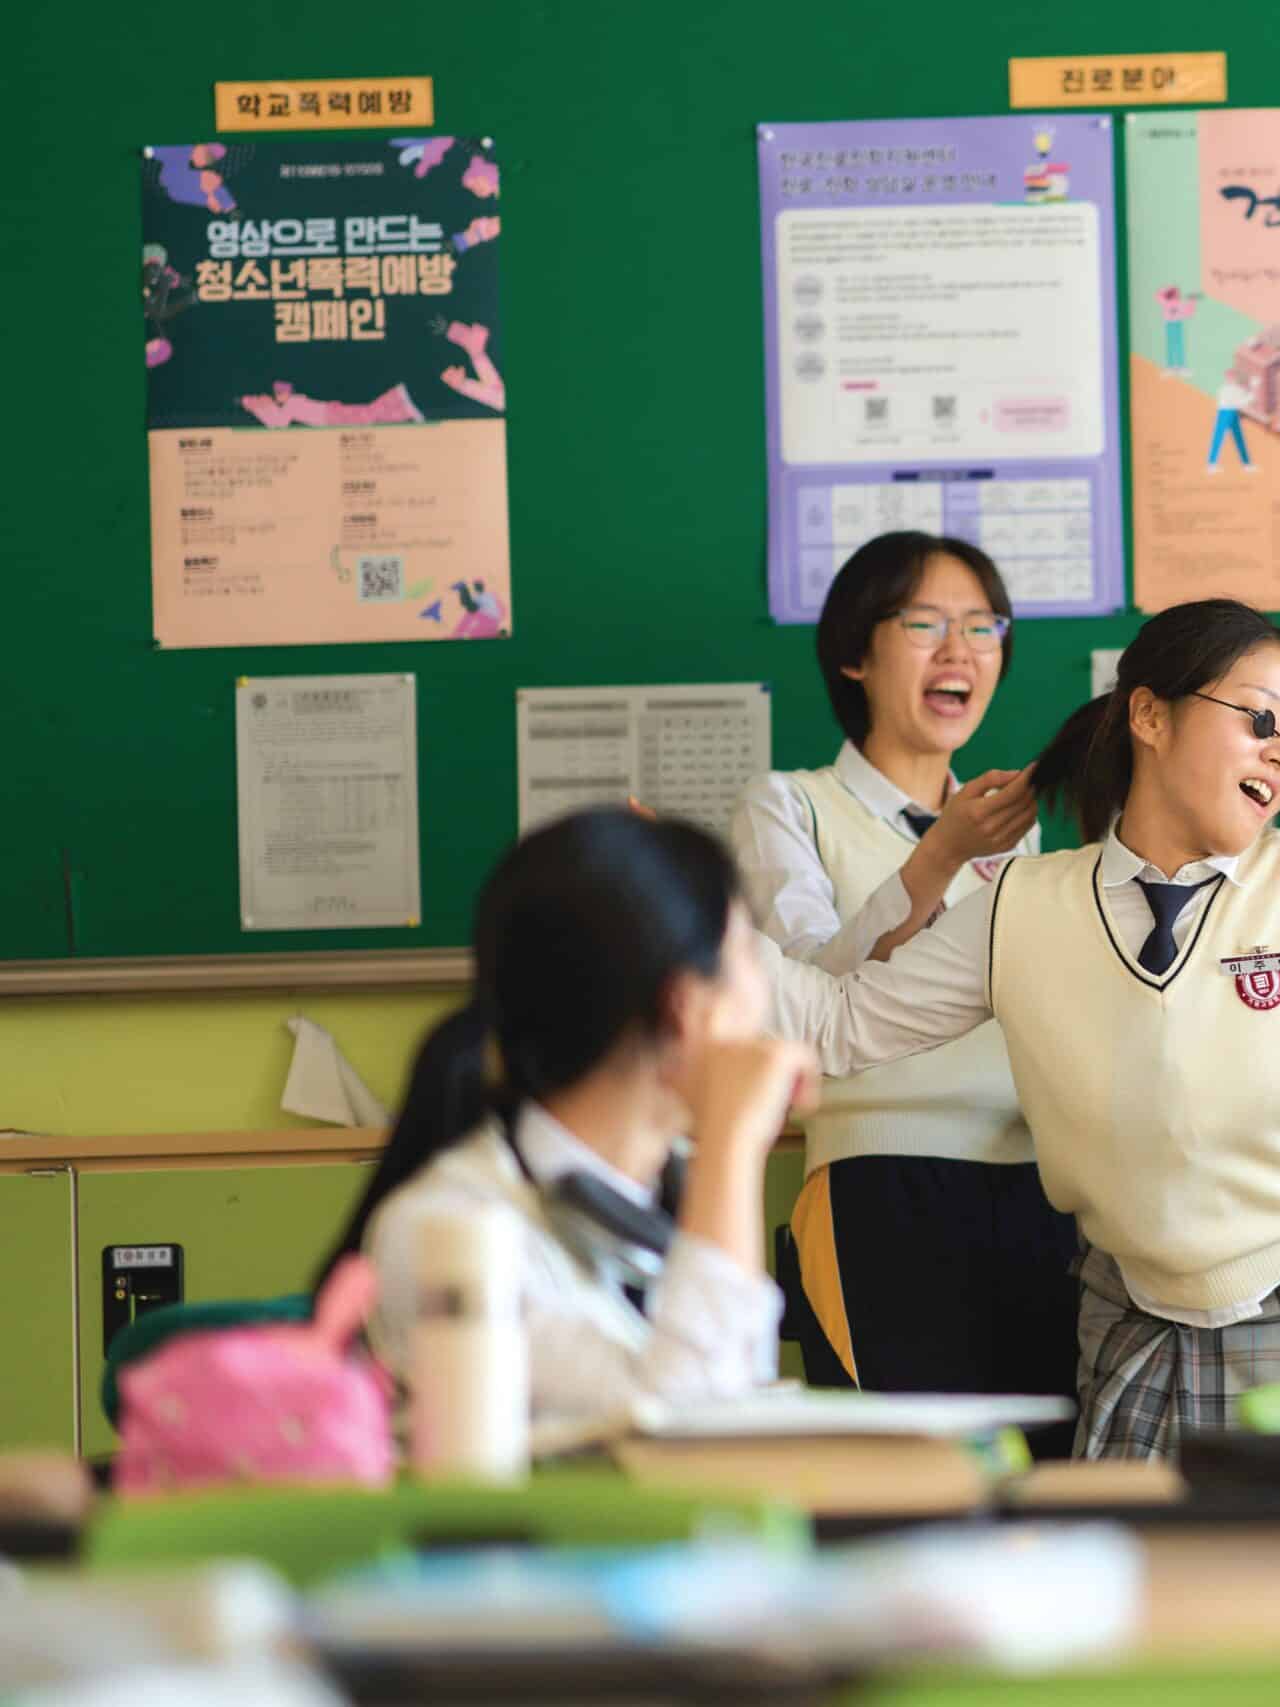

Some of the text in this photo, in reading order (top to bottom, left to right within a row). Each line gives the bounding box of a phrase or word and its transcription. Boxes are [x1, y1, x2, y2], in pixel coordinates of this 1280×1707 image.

[1062, 66, 1175, 94] 진로분야
[236, 89, 413, 118] 학교폭력예방
[207, 214, 443, 258] 영상으로 만드는
[196, 254, 456, 303] 청소년폭력예방
[274, 299, 385, 343] 캠페인
